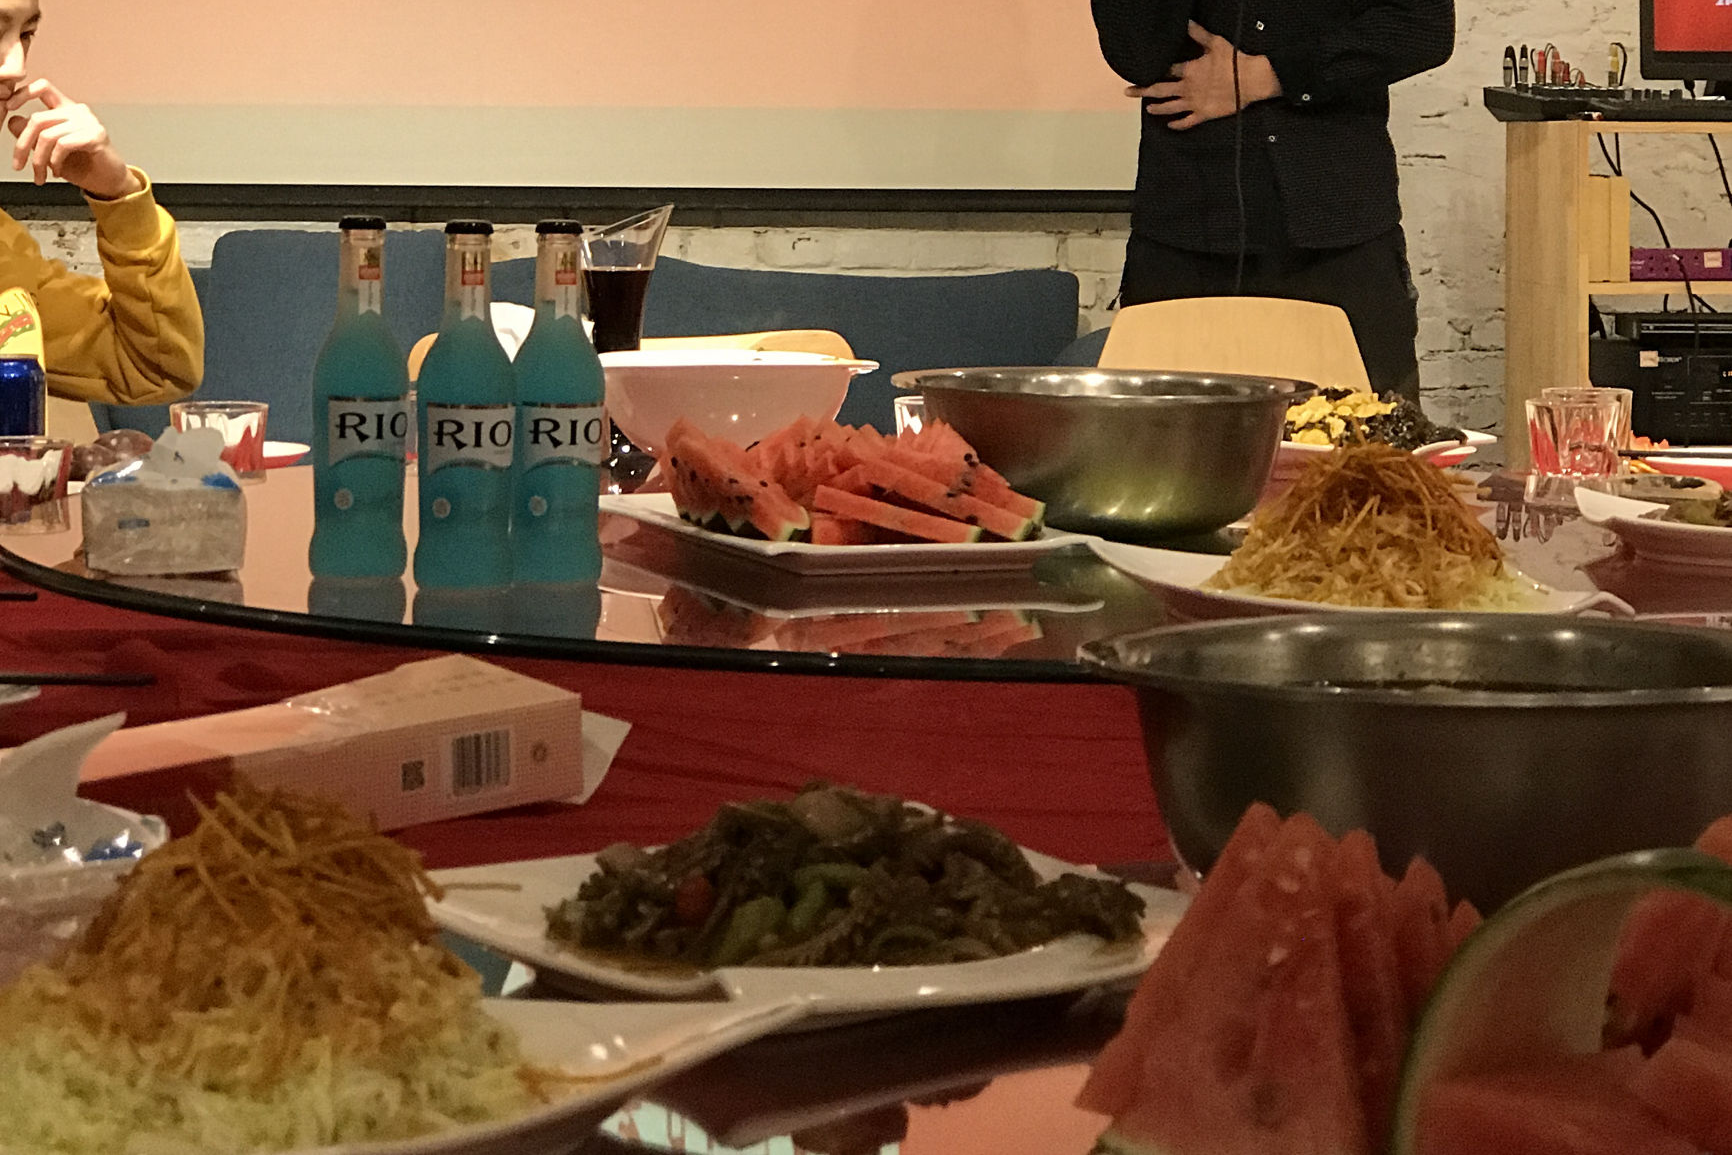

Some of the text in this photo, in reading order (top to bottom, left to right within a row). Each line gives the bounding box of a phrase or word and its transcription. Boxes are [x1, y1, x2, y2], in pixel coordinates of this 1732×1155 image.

[335, 412, 408, 443] RIO
[433, 419, 512, 450] RIO
[528, 417, 603, 449] RIO
